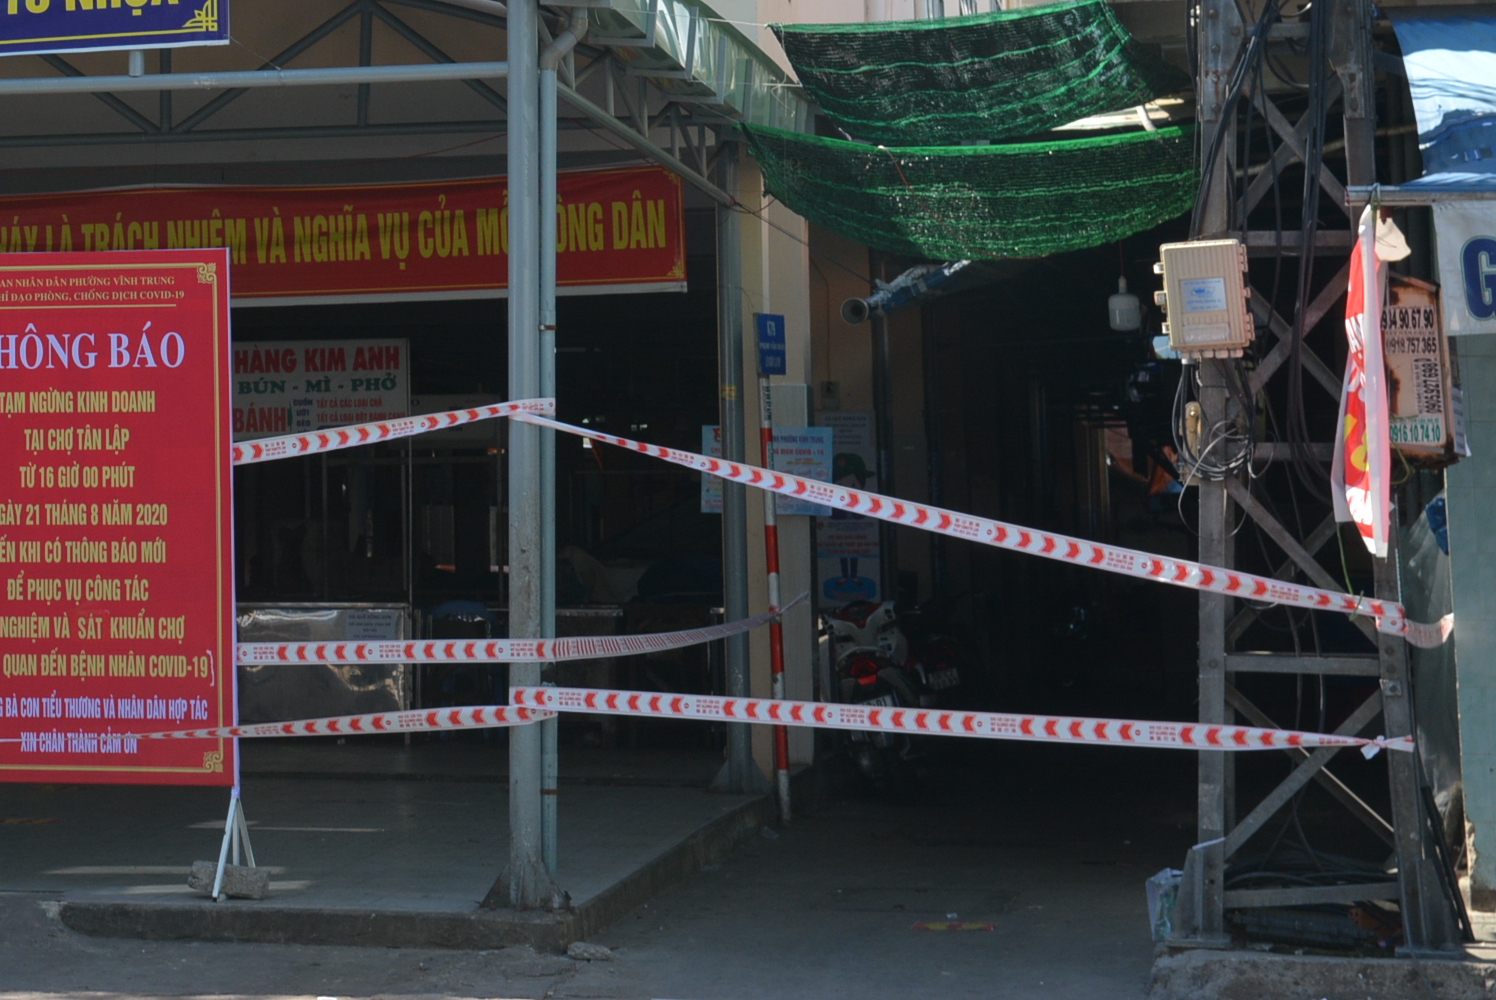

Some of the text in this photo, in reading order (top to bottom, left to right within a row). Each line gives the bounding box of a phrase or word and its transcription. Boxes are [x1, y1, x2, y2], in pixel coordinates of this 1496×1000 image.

[254, 206, 287, 264] VÀ
[294, 205, 371, 264] NGHĨA
[376, 212, 410, 270] VỤ
[417, 194, 470, 259] CỦA
[612, 190, 667, 250] DÂN
[14, 276, 45, 288] NHÂN
[46, 275, 68, 287] DÂN
[69, 274, 112, 287] PHƯỜNG
[113, 274, 139, 286] VĨNH
[140, 275, 175, 286] TRUNG
[11, 292, 33, 304] ĐẠO
[34, 290, 72, 302] PHÒNG,
[73, 289, 111, 301] CHỐNG
[112, 290, 138, 302] DỊCH
[139, 290, 185, 300] COVID-19
[107, 320, 185, 369] BÁO
[234, 345, 400, 374] HÀNG KIM ANH
[237, 372, 397, 395] BÚN MÌ PHỞ
[29, 387, 74, 414] NGỪNG
[77, 391, 108, 413] KINH
[111, 390, 156, 413] DOANH
[234, 402, 287, 433] BÁNH
[24, 424, 130, 456] TẠI CHỢ TÂN LẬP
[19, 460, 136, 489] TỪ 16 GIỜ 00 PHÚT
[25, 503, 41, 526] 21
[45, 498, 87, 526] THÁNG
[90, 503, 99, 526] 8
[102, 499, 133, 526] NĂM
[136, 503, 168, 526] 2020
[19, 541, 41, 563] KHI
[44, 536, 62, 563] CÓ
[65, 537, 108, 563] THÔNG
[111, 536, 137, 563] BÁO
[141, 536, 166, 564] MỚI
[7, 569, 149, 606] ĐỂ PHỤC VỤ CÔNG TÁC
[0, 611, 50, 643] NGHIỆM
[53, 611, 71, 639] VÀ
[77, 613, 103, 640] SÁT
[110, 608, 155, 640] KHUẨN
[158, 615, 186, 644] CHỢ
[3, 653, 38, 678] QUAN
[40, 647, 67, 677] ĐẾN
[70, 650, 105, 682] BỆNH
[108, 650, 146, 678] NHÂN
[5, 693, 19, 718] BÀ
[20, 697, 40, 718] CON
[42, 689, 62, 719] TIỂU
[64, 695, 101, 719] THƯƠNG
[103, 694, 116, 719] VÀ
[117, 694, 145, 720] NHÂN
[146, 694, 166, 720] DÂN
[168, 697, 188, 725] HỢP
[189, 695, 208, 721] TÁC
[20, 731, 37, 753] XIN
[39, 728, 65, 753] CHÂN
[67, 729, 98, 754] THÀNH
[100, 725, 122, 754] CẢM
